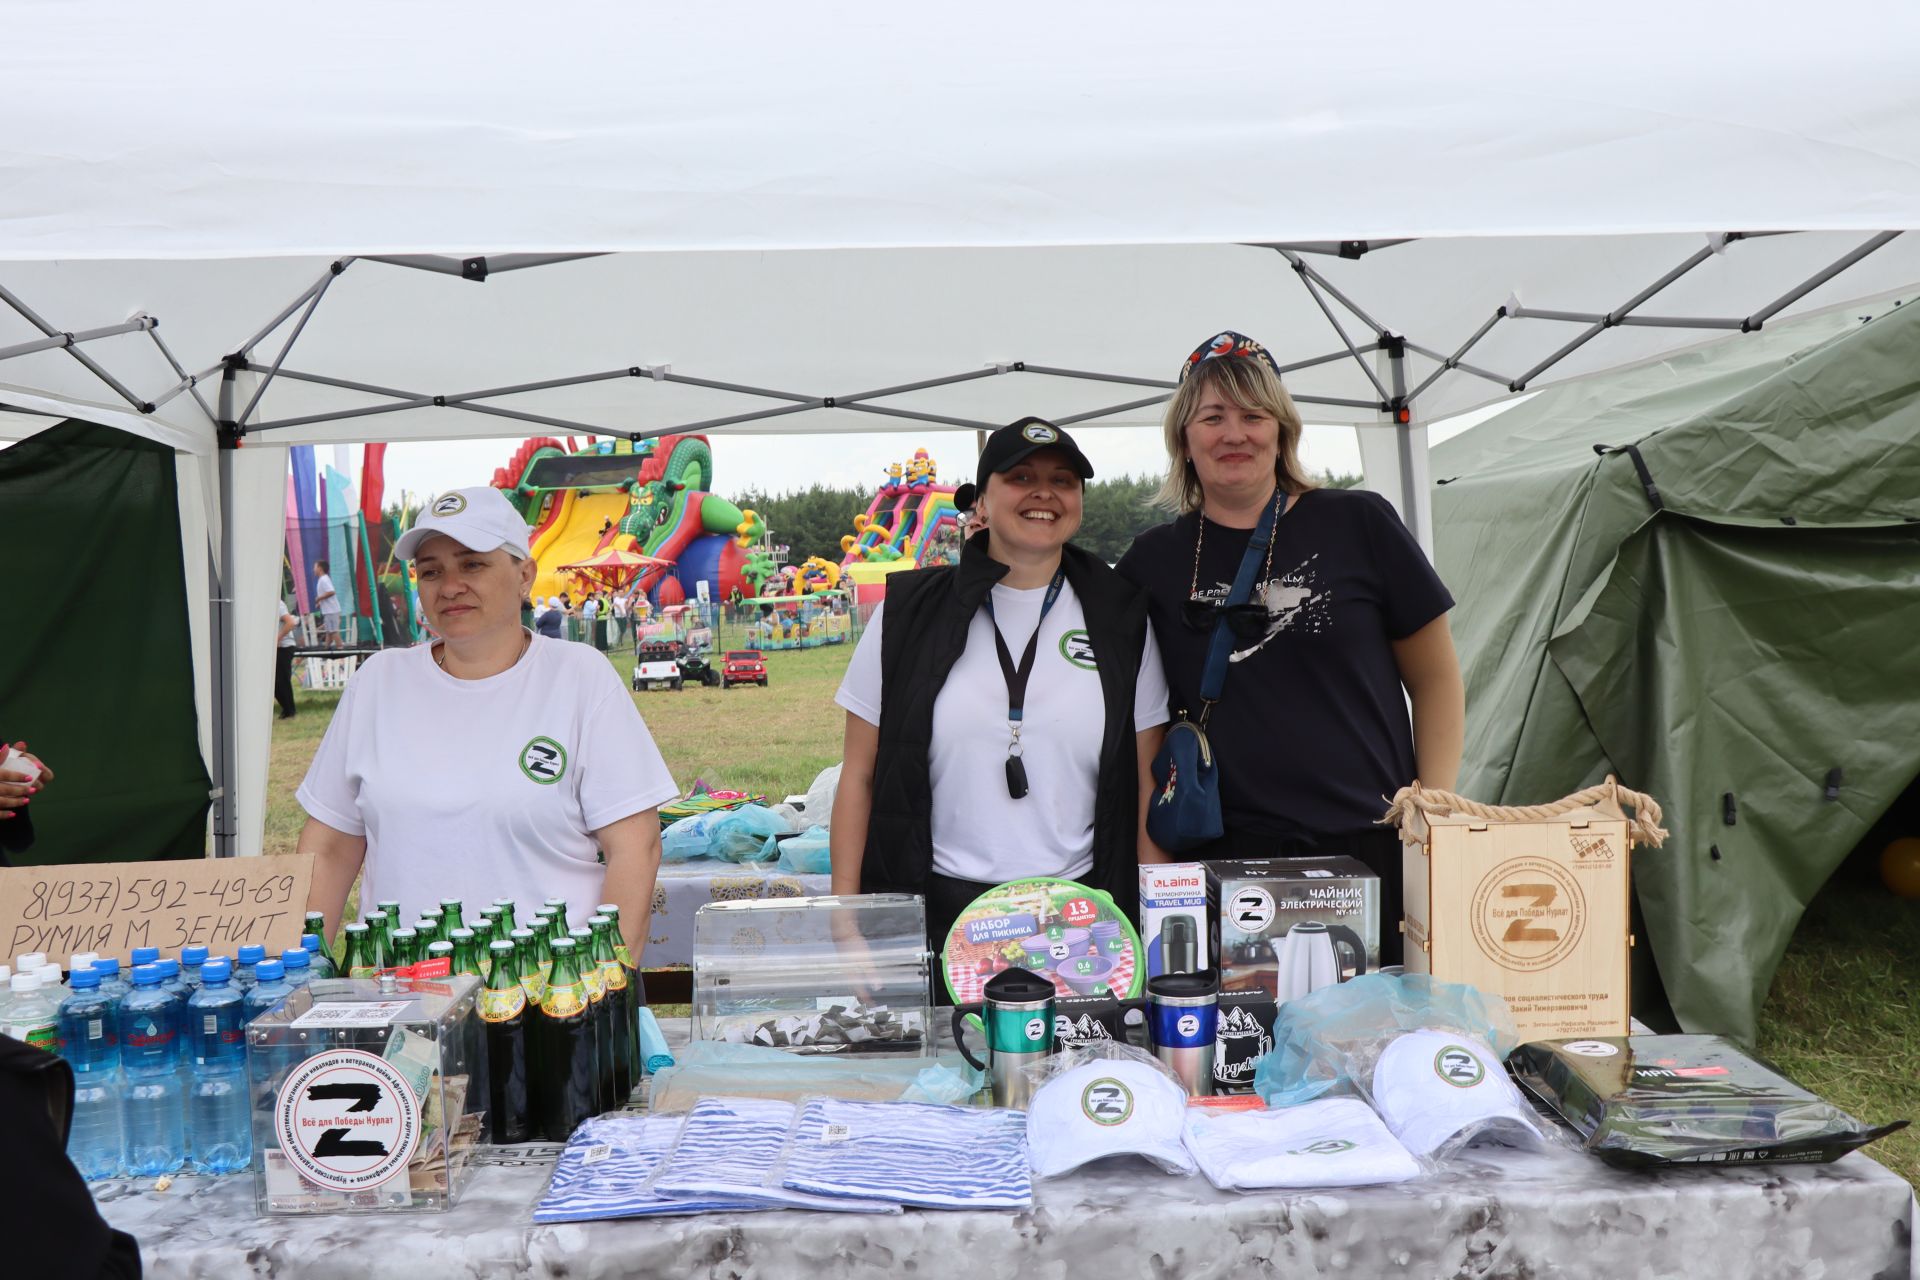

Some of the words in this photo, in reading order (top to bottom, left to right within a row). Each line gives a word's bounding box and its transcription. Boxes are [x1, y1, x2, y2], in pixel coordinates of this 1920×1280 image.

[1162, 876, 1199, 888] Laima
[1310, 885, 1362, 898] ЧАЙНИК
[1069, 901, 1088, 915] 13
[1280, 899, 1362, 910] ЭЛЕКТРИЧЕСКИЙ
[1068, 914, 1096, 922] ПРЕДМЕТОВ
[1492, 908, 1505, 918] Всё
[1520, 908, 1545, 918] Победы
[1502, 884, 1560, 942] Z
[971, 918, 1010, 932] НАБОР
[8, 923, 113, 959] РУМИЯ
[124, 920, 151, 948] М
[166, 912, 289, 948] ЗЕНИТ
[972, 932, 990, 942] ДЛЯ
[992, 926, 1032, 938] ПИКНИКА
[1588, 992, 1609, 1002] труда
[346, 1058, 379, 1070] ветеранов
[376, 1066, 391, 1081] войны
[302, 1117, 316, 1127] Всё
[318, 1118, 332, 1126] для
[334, 1116, 365, 1126] Победы
[366, 1116, 393, 1126] Нурлат
[307, 1083, 390, 1158] Z
